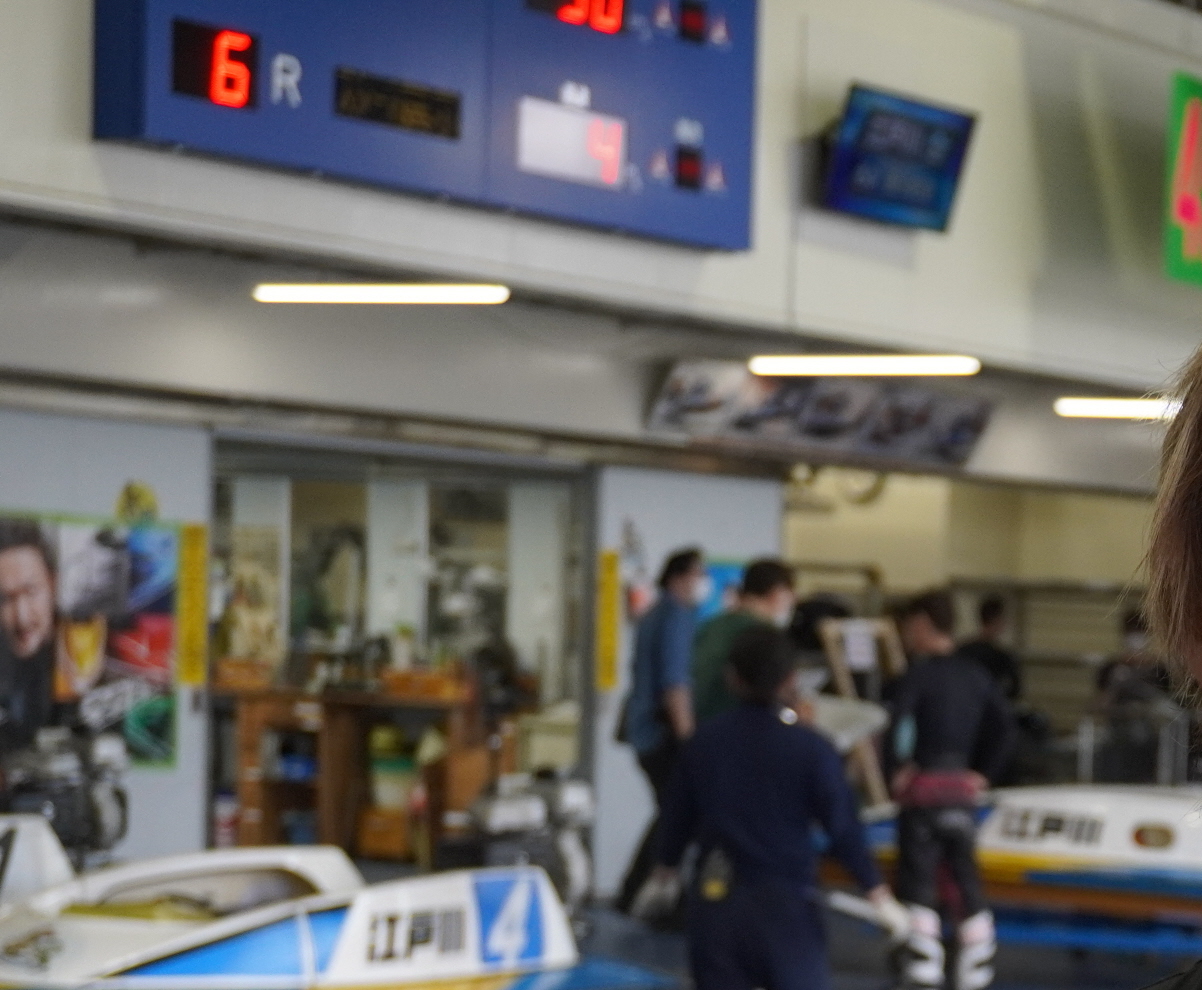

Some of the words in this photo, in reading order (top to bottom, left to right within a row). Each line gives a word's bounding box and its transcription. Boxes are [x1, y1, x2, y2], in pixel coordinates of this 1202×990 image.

[209, 29, 252, 109] 6
[270, 52, 303, 109] R
[586, 118, 622, 184] 4
[486, 870, 535, 968] 4
